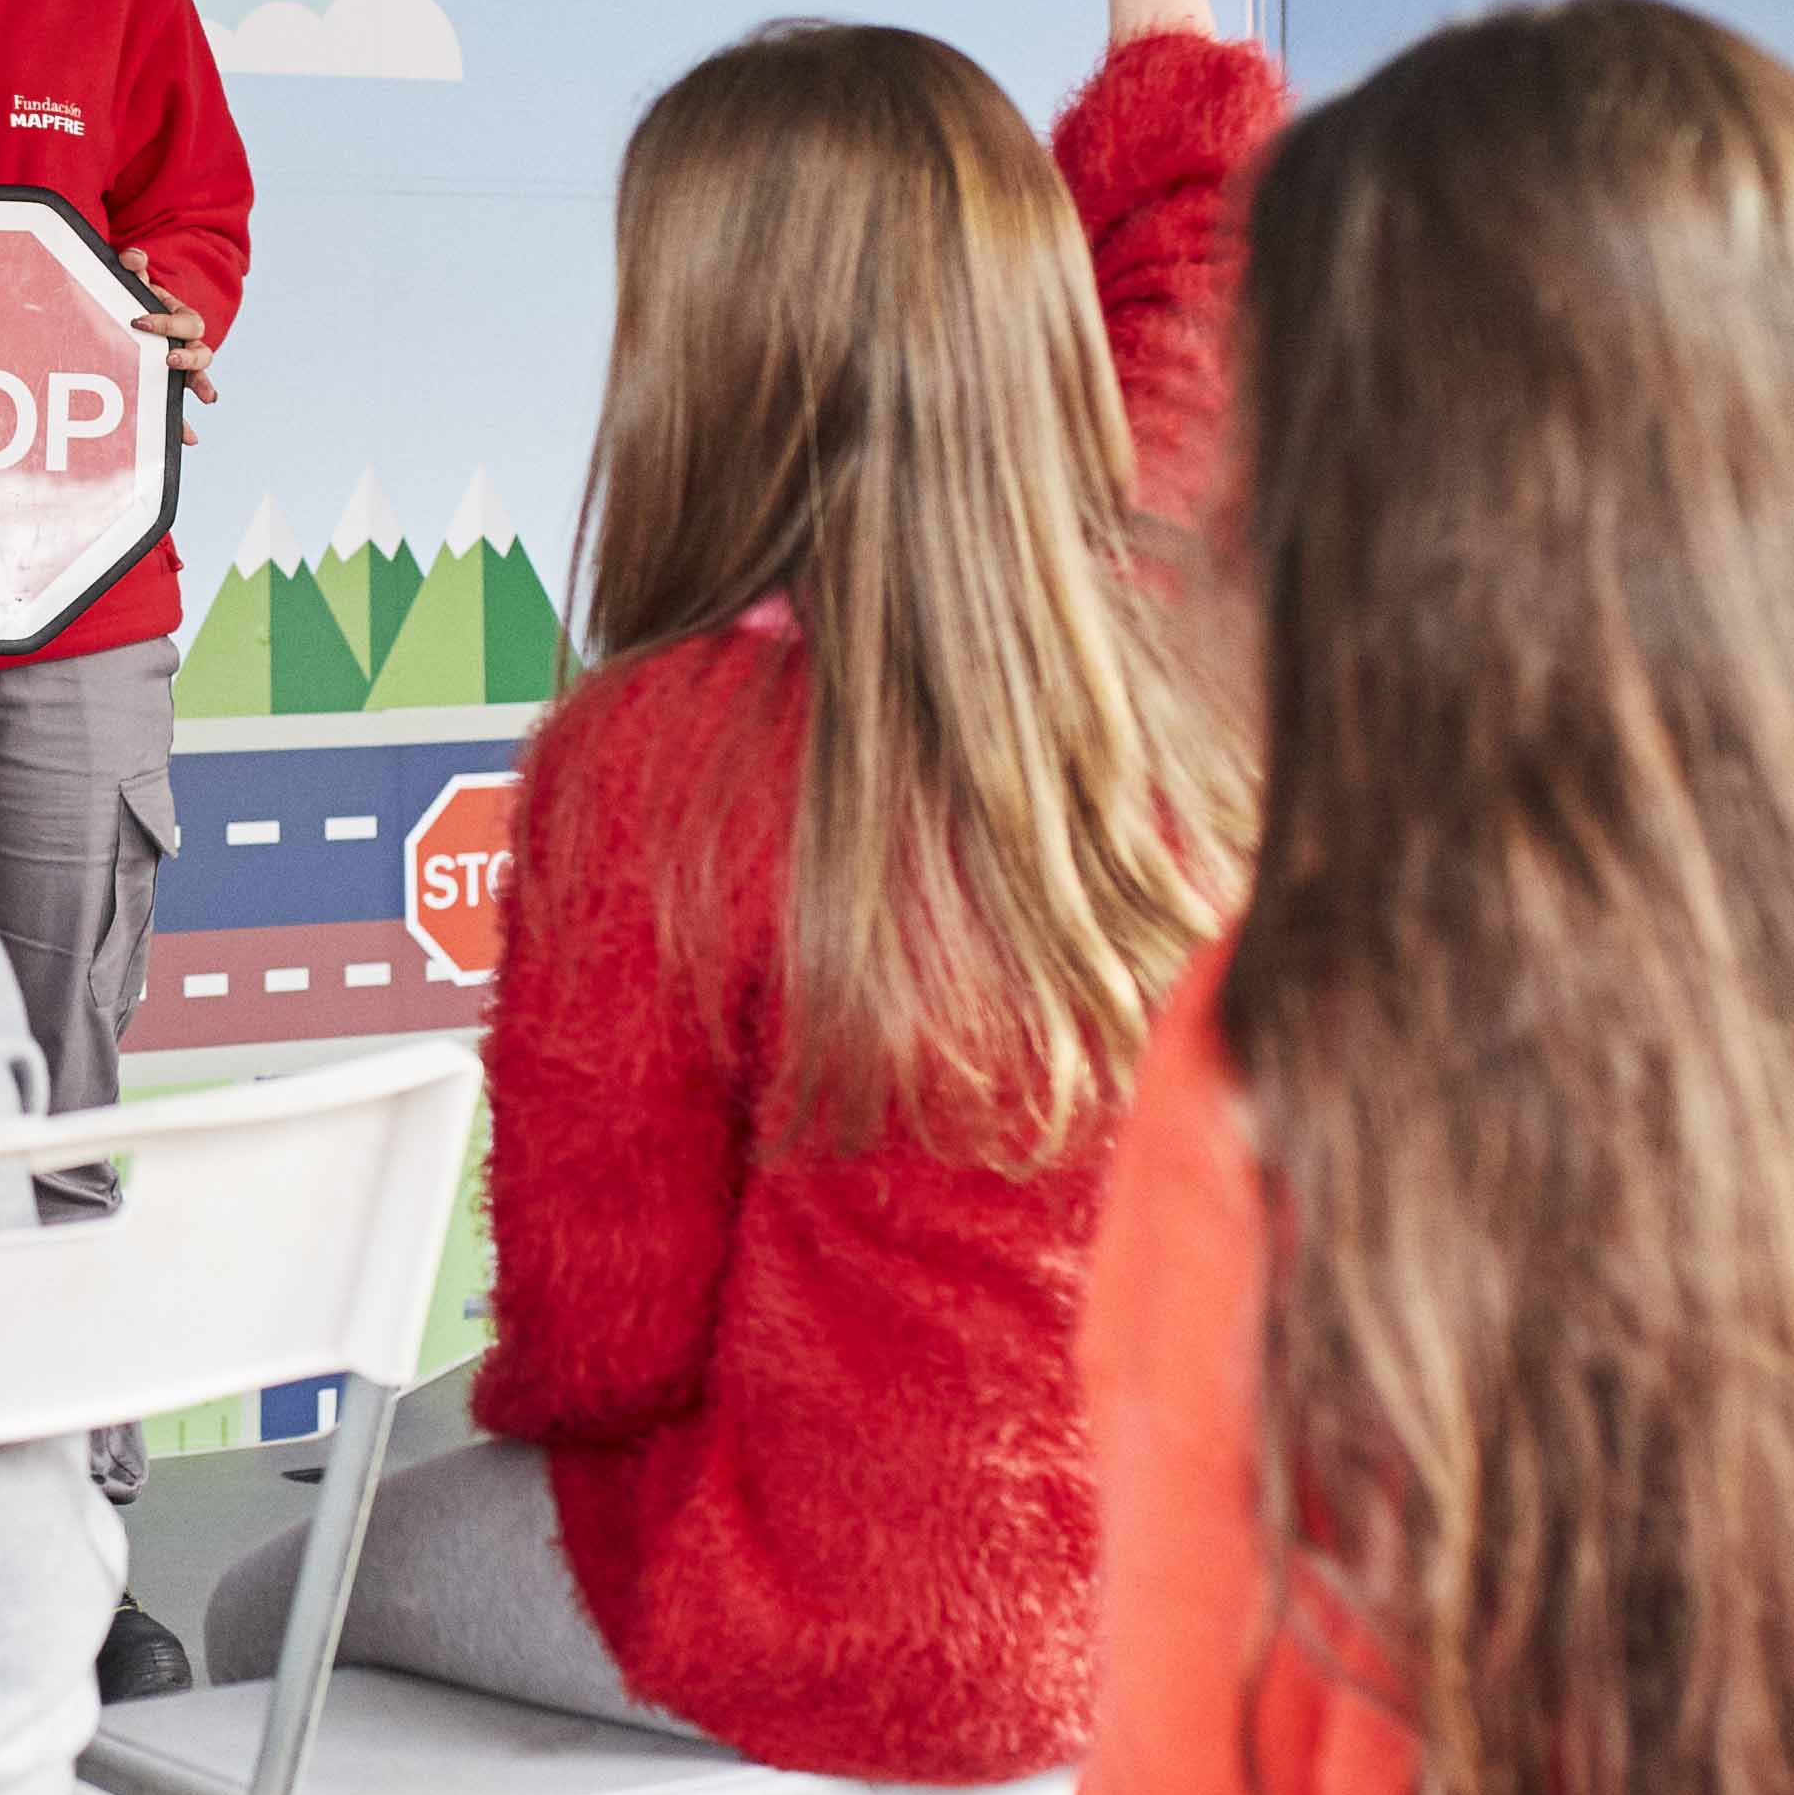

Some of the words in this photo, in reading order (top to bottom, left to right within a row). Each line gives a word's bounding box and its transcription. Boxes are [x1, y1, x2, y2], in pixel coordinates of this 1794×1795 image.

[13, 94, 82, 118] Fundación
[9, 112, 86, 137] MAPFRE
[422, 849, 515, 910] STO
